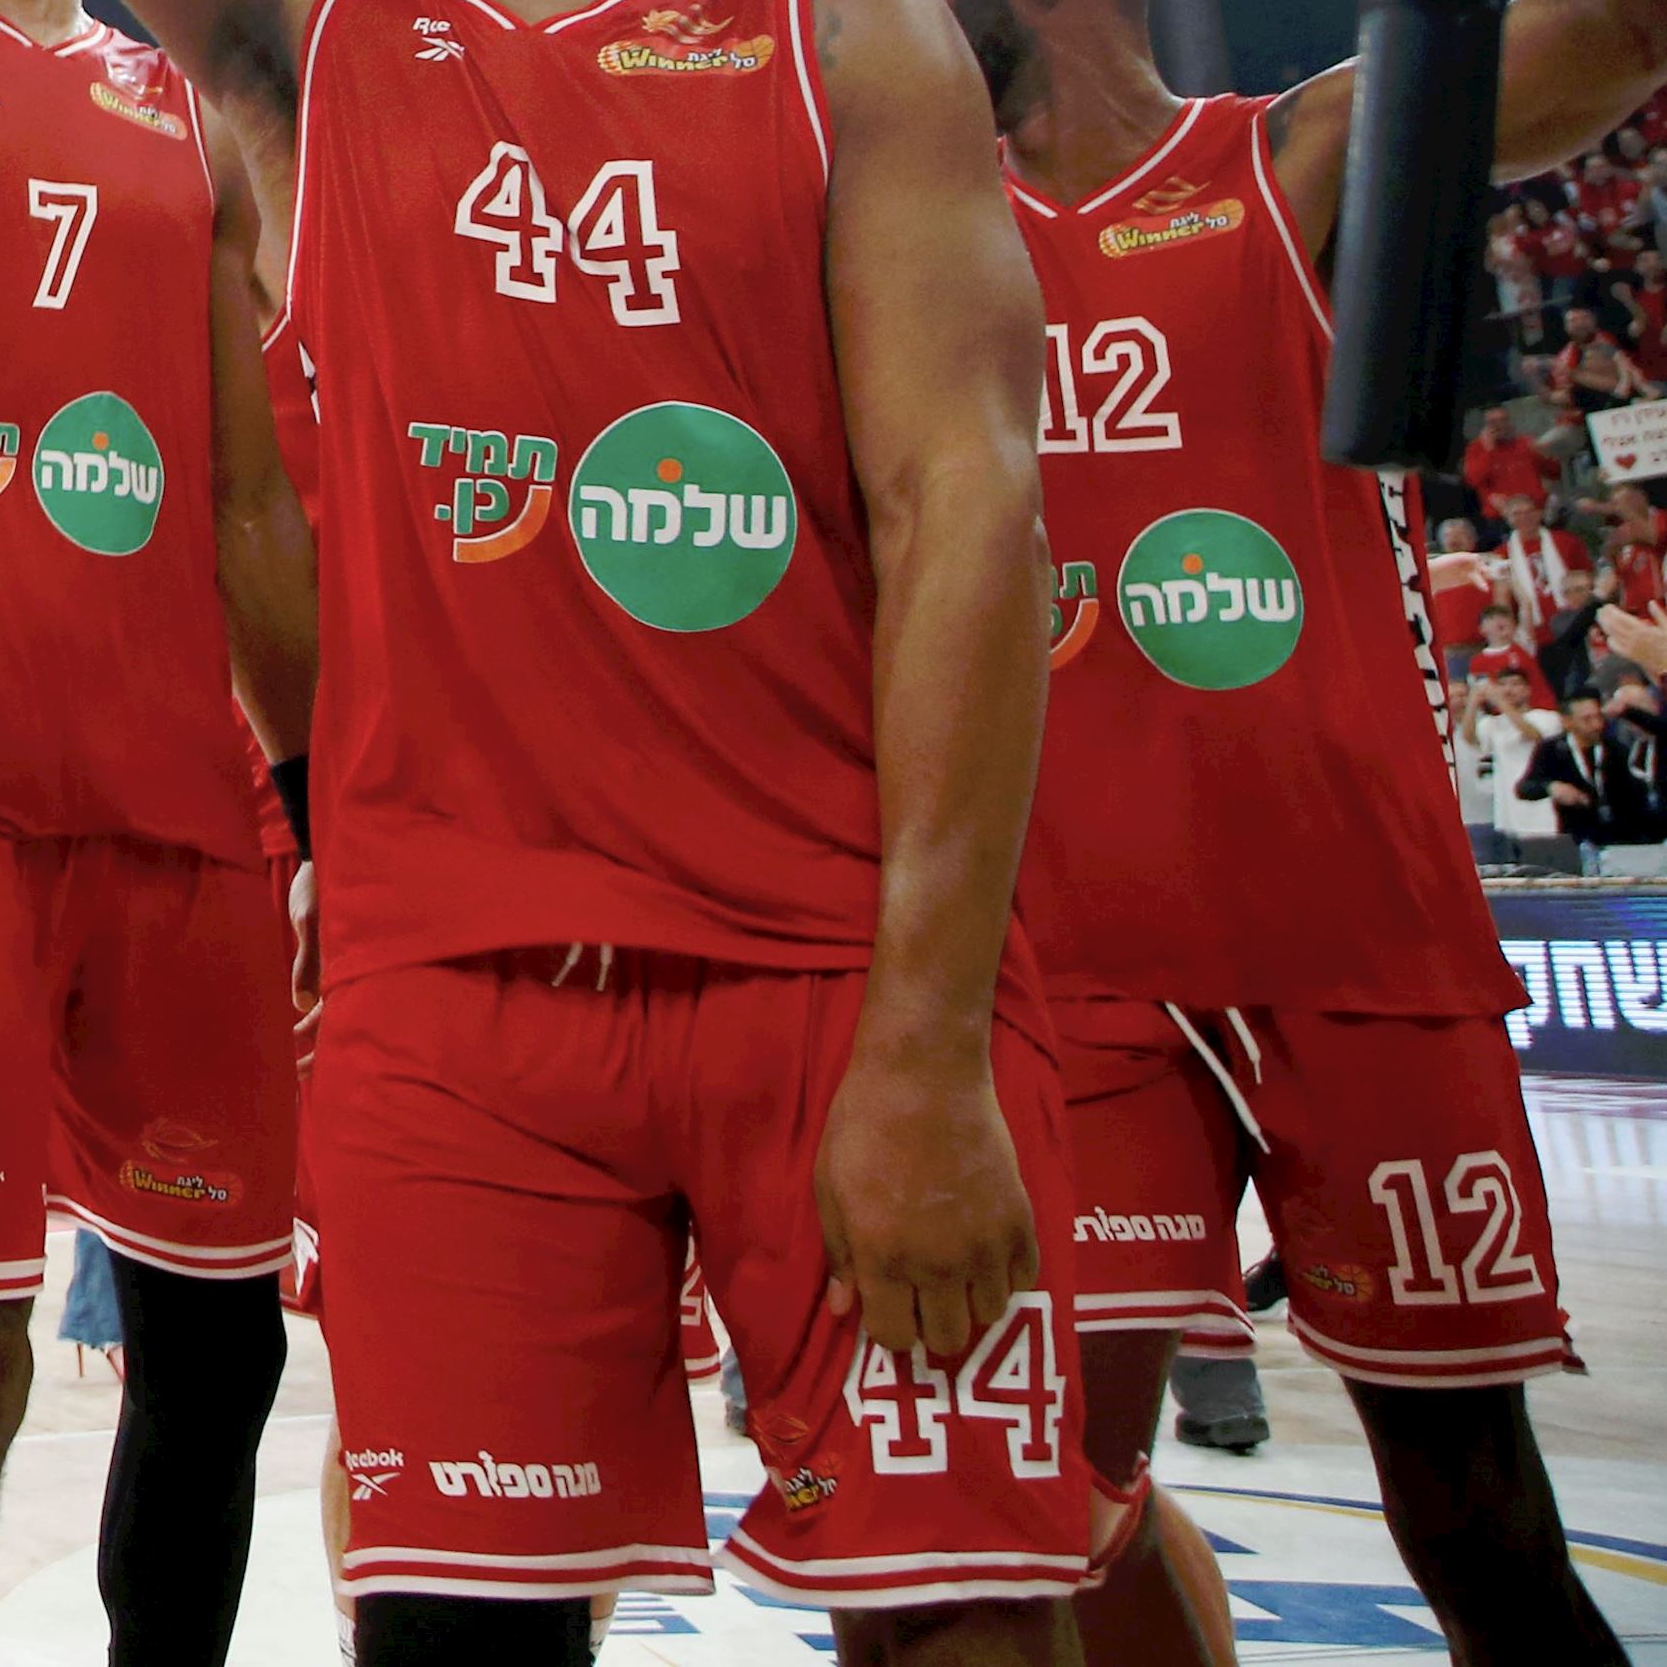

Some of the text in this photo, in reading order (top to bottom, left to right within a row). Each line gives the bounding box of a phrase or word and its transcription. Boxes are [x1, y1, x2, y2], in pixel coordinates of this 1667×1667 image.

[619, 43, 729, 72] Winner
[27, 178, 99, 311] 7
[453, 140, 682, 328] 44
[1116, 221, 1205, 251] Winner
[1038, 316, 1183, 454] 12
[40, 449, 159, 505] שלמה
[408, 422, 559, 484] תמיד
[579, 483, 789, 551] שלמה
[1125, 571, 1298, 628] שלמה
[134, 1168, 206, 1200] Winner
[1368, 1149, 1546, 1307] 12
[843, 1290, 1067, 1479] 44
